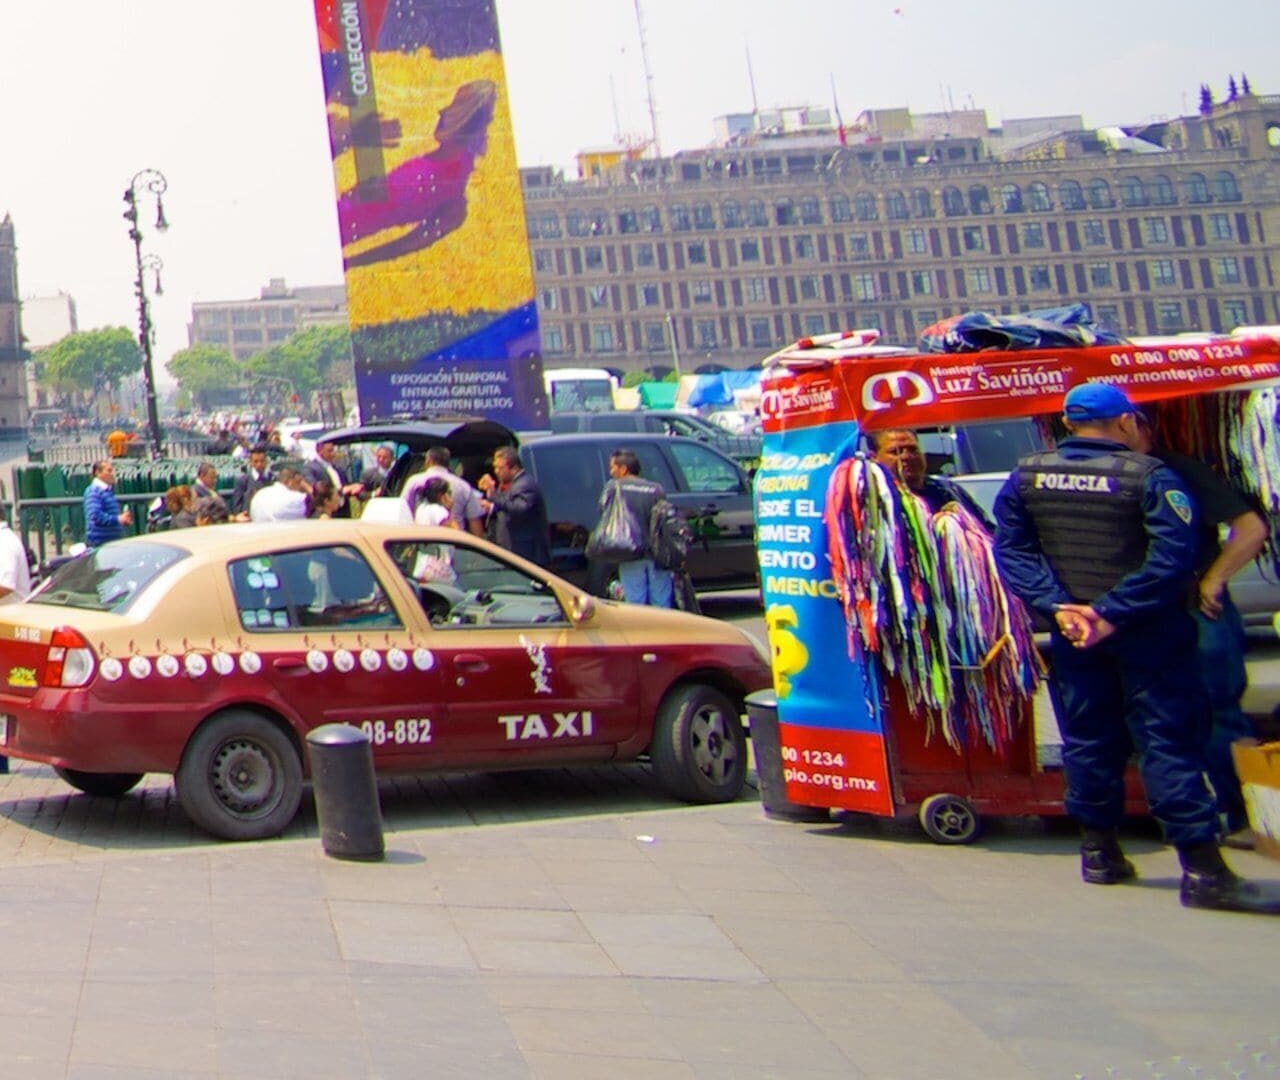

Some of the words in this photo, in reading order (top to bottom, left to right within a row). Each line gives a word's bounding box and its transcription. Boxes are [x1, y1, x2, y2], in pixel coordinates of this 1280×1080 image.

[341, 1, 368, 96] COLECCIÓN
[1110, 353, 1131, 367] 01
[1133, 351, 1164, 365] 800
[1167, 348, 1200, 363] 000
[1203, 345, 1243, 360] 1234
[452, 371, 509, 384] TEMPORAL
[933, 375, 974, 394] Luz
[977, 366, 1064, 391] Saviñón
[401, 386, 450, 398] ENTRADA
[451, 385, 501, 397] GRATUITA
[392, 401, 409, 411] NO
[425, 399, 472, 410] ADMITEN
[1035, 473, 1111, 493] POLICIA
[795, 499, 822, 518] EL
[498, 711, 593, 740] TAXI
[802, 749, 844, 768] 1234
